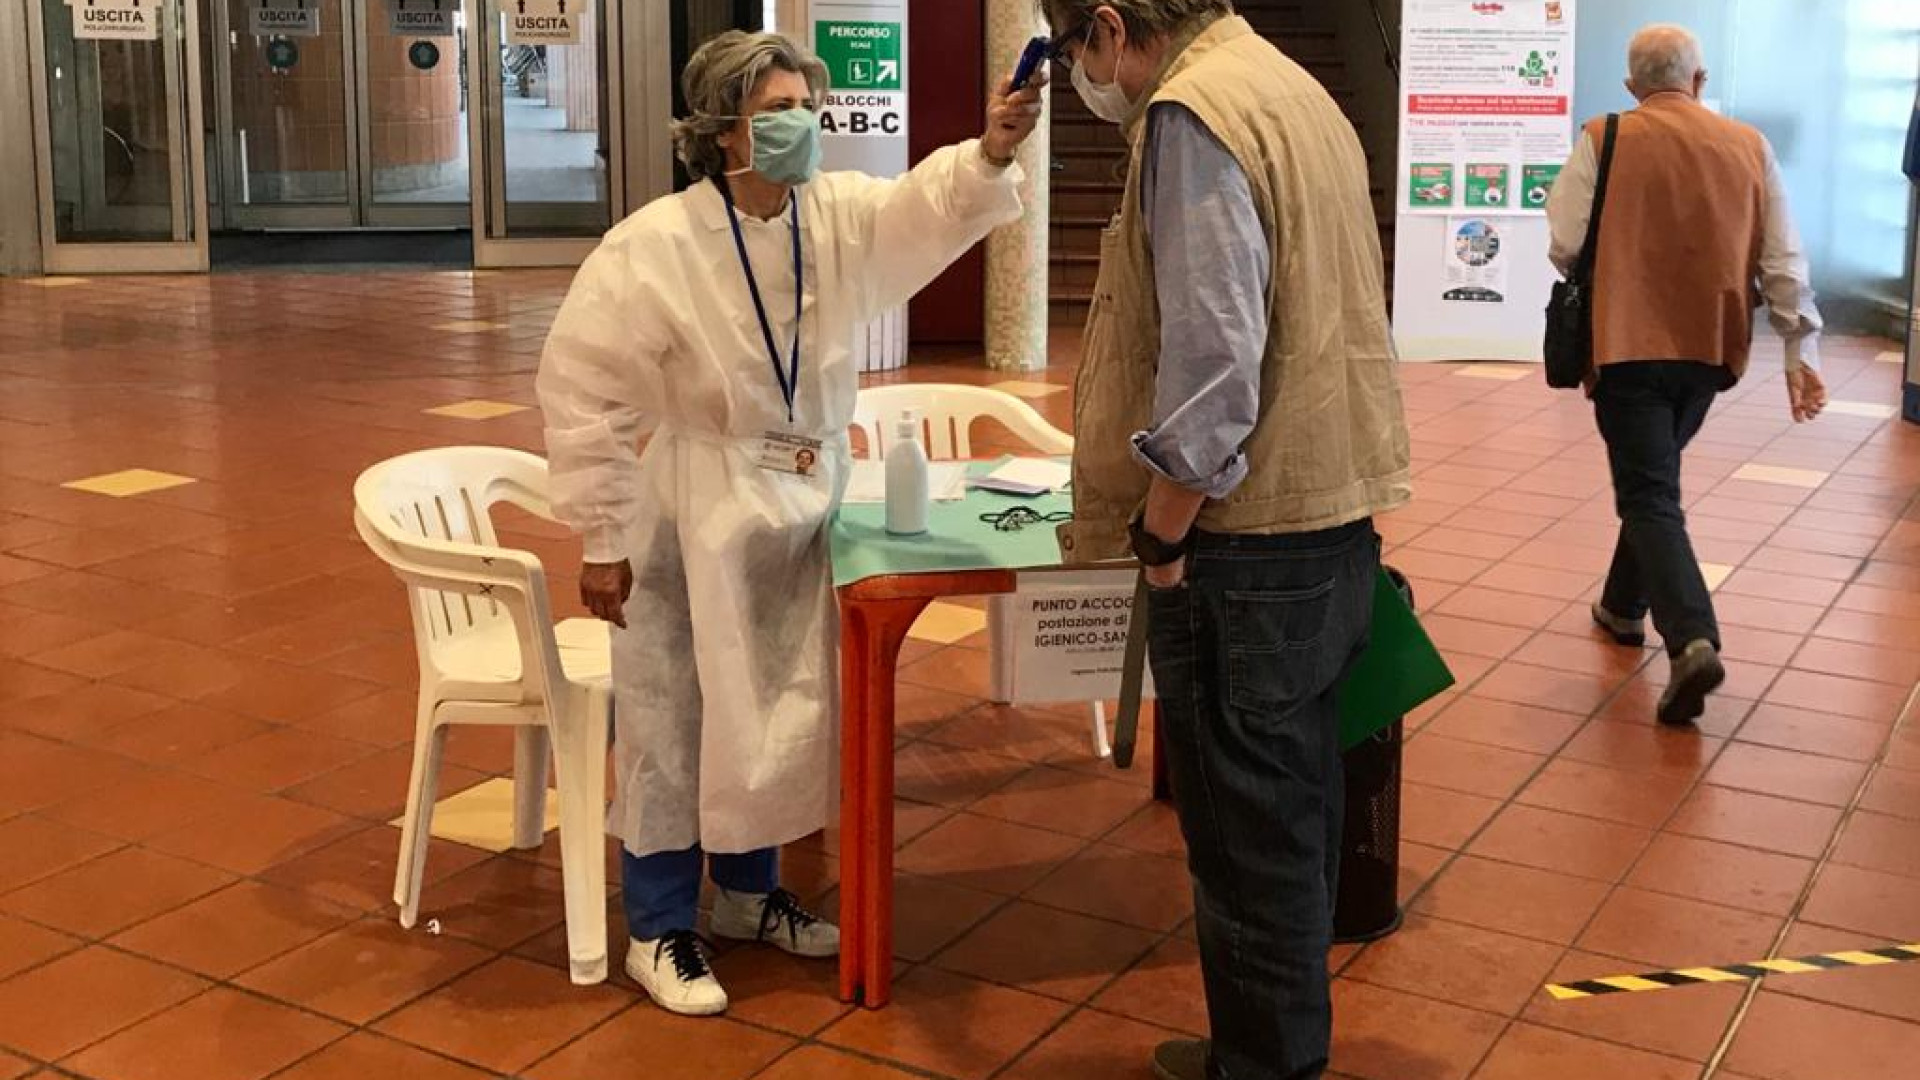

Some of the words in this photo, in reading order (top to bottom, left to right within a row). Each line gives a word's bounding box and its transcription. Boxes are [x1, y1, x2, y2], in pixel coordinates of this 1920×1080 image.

[84, 9, 144, 24] USCITA
[259, 10, 307, 22] USCITA
[397, 12, 443, 24] USCITA
[515, 17, 569, 29] USCITA
[829, 26, 890, 38] PERCORSO
[826, 95, 891, 106] BLOCCHI
[820, 110, 899, 134] A-B-C
[1033, 599, 1077, 612] PUNTO
[1038, 616, 1110, 632] postazione
[1115, 613, 1127, 625] di
